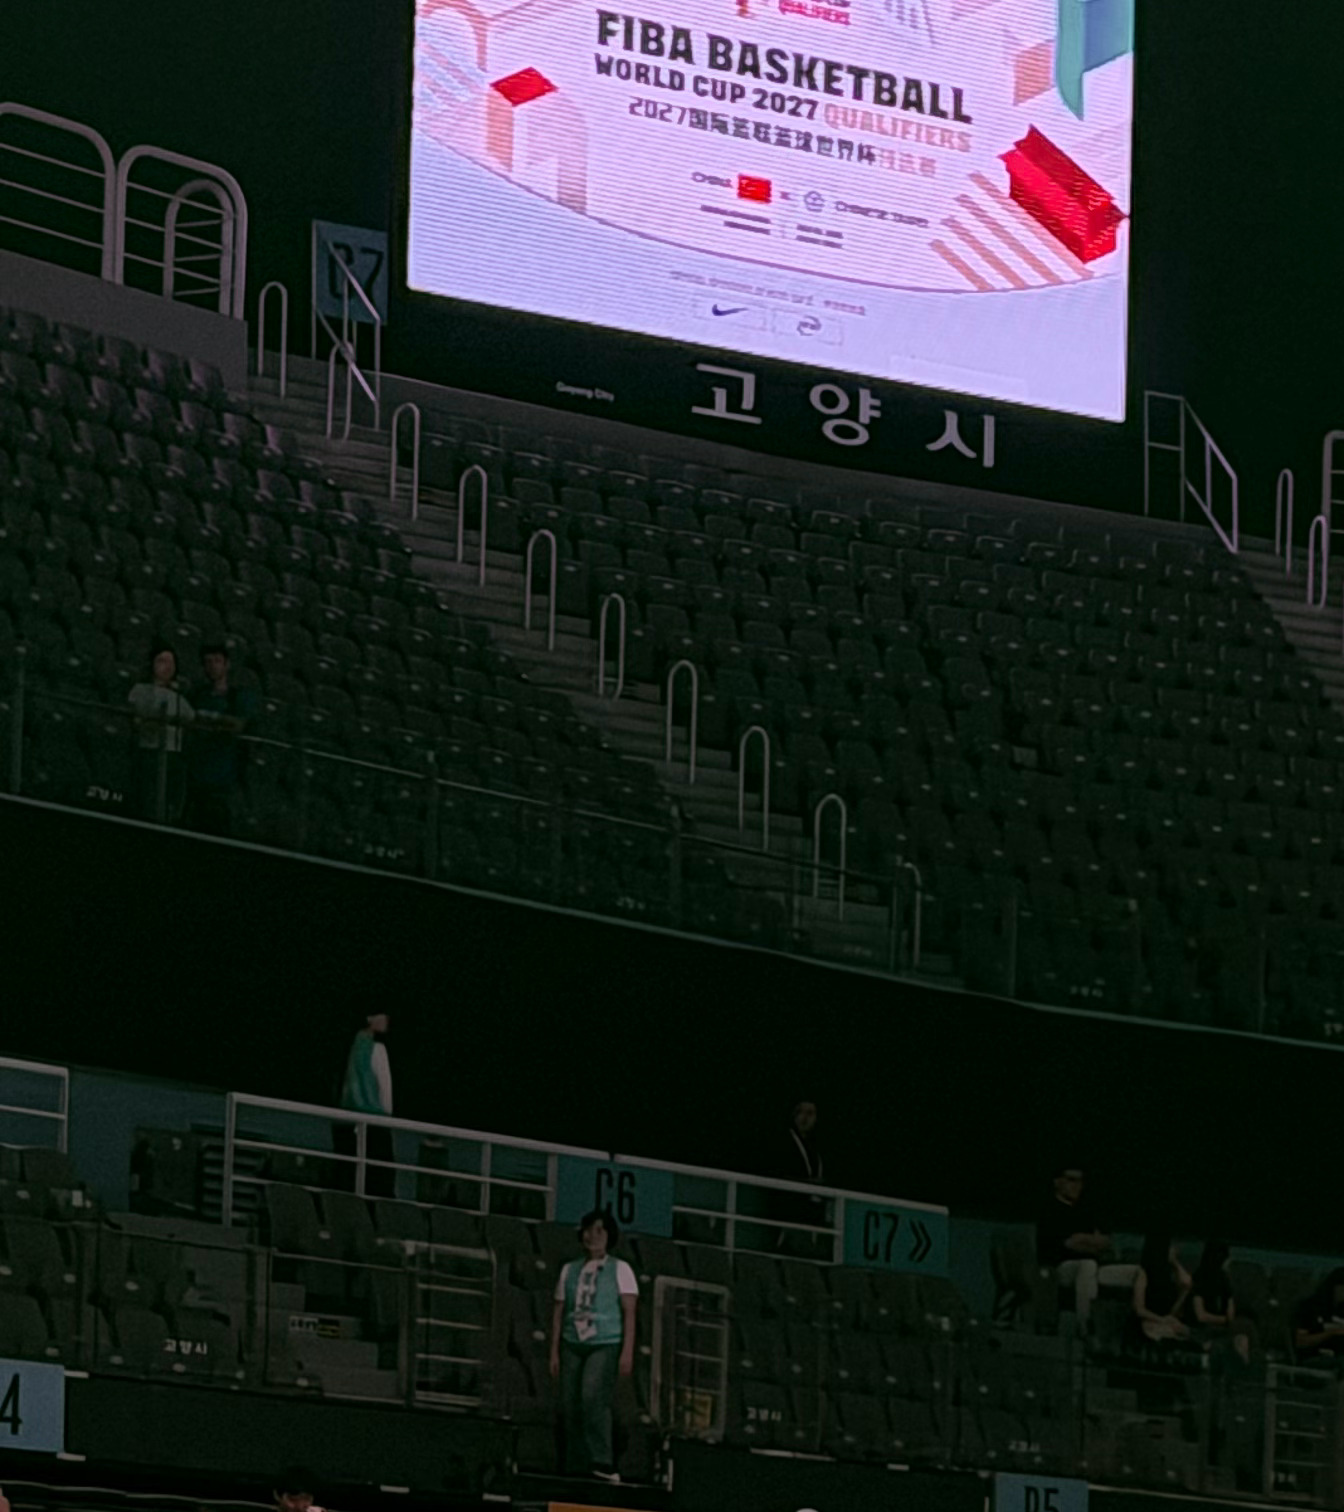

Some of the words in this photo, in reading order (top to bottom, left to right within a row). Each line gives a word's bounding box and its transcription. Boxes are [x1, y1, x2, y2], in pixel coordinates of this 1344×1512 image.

[594, 53, 685, 91] WORLD
[693, 75, 746, 103] CUP
[752, 88, 819, 120] 2027
[824, 103, 973, 152] QUALIFIERS
[596, 9, 696, 65] FIBA
[706, 33, 973, 124] BASKETBALL
[691, 363, 996, 468] 고양시
[595, 1168, 635, 1224] C6
[863, 1209, 898, 1262] C7
